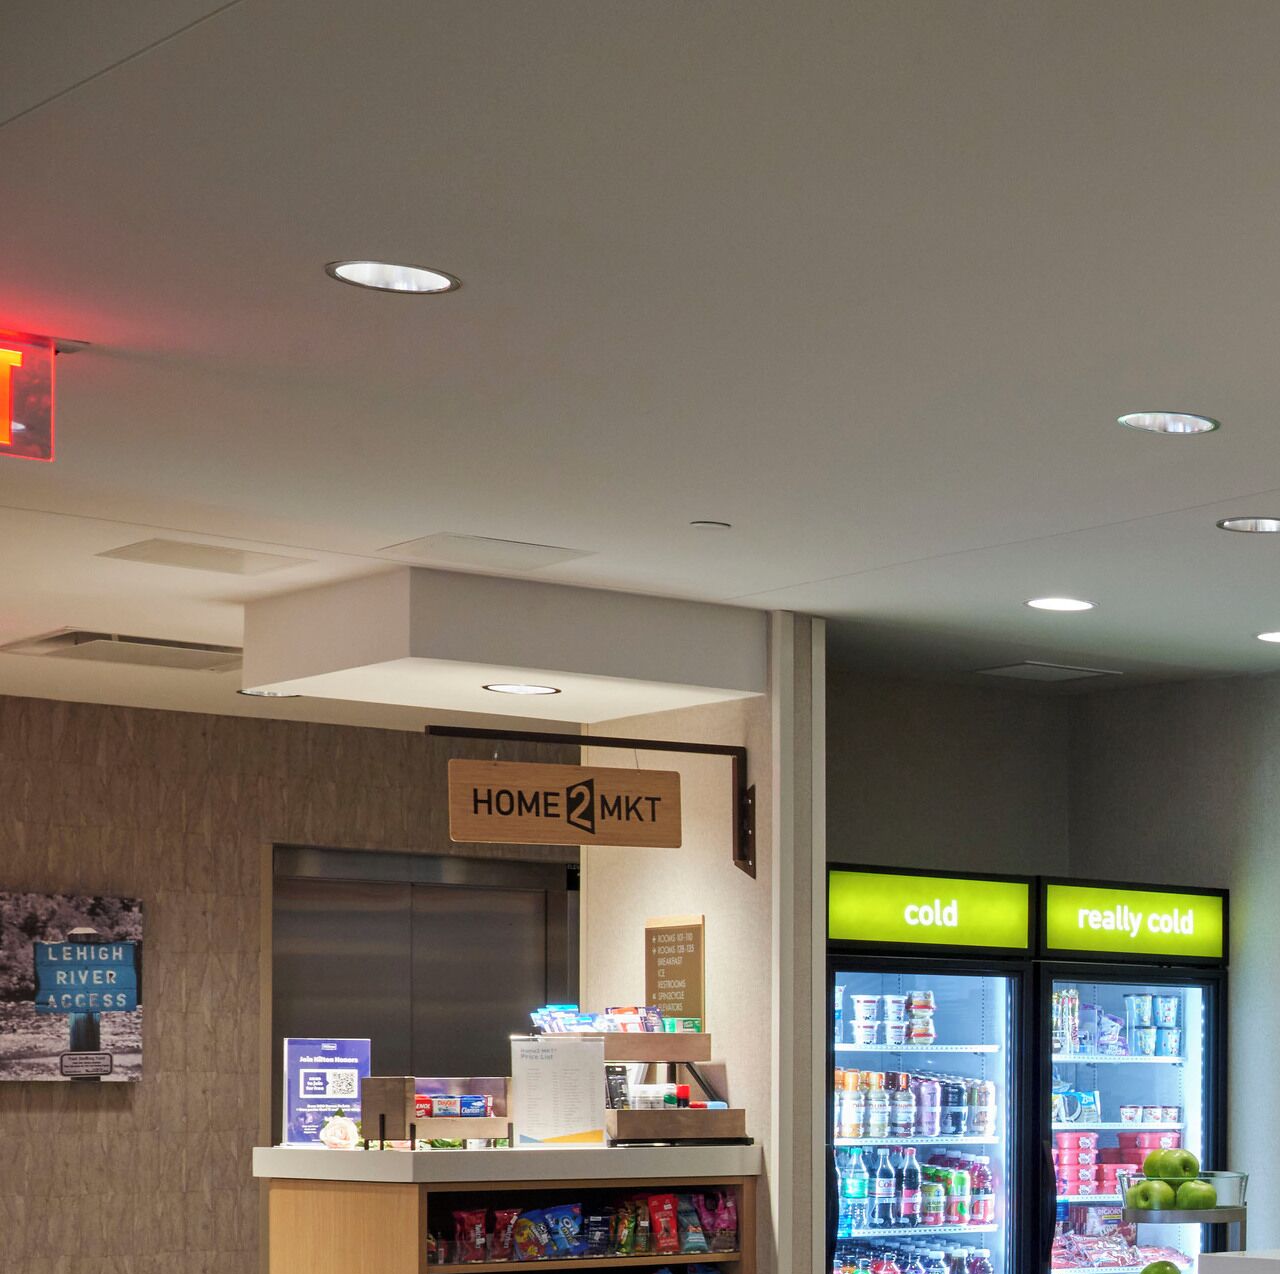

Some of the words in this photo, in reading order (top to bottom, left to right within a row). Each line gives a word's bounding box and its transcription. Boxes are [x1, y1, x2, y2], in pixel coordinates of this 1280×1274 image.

[904, 899, 958, 927] cold
[1078, 905, 1142, 937] really
[1147, 908, 1194, 935] cold
[48, 946, 123, 960] LEHIGH
[56, 970, 117, 985] RIVER
[48, 993, 127, 1008] ACCESS
